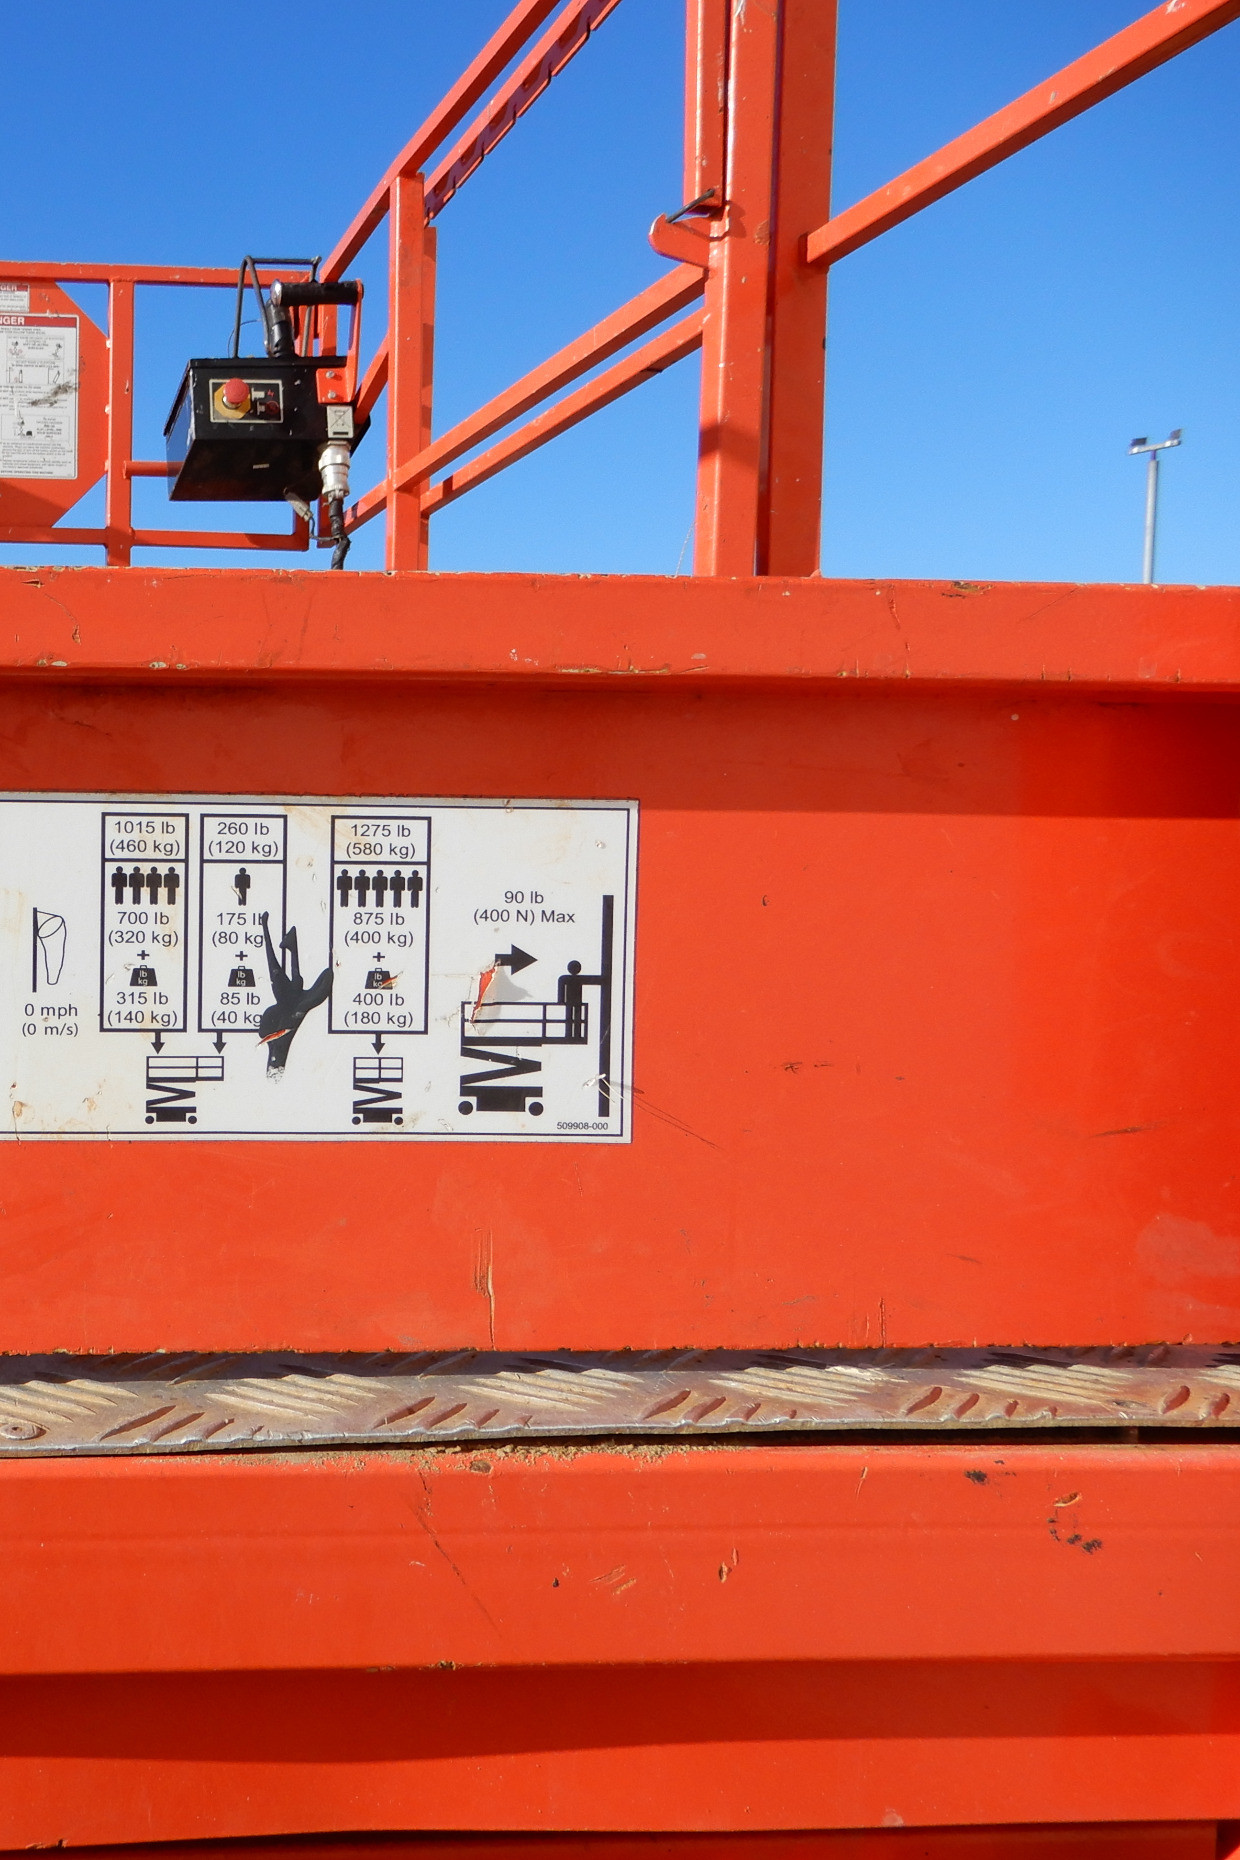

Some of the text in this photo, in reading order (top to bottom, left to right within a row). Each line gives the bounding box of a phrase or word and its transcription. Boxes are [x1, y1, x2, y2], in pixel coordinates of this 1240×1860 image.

[114, 820, 176, 834] 1015 lb
[216, 822, 270, 836] 260 lb
[350, 824, 412, 838] 1275 lb
[109, 839, 180, 856] (460 kg)
[208, 840, 279, 858] (120 kg)
[346, 842, 416, 860] (580 kg)
[504, 890, 545, 904] 90 lb
[117, 911, 170, 925] 700 lb
[216, 912, 247, 926] 175
[353, 911, 405, 926] 875 lb
[473, 908, 575, 926] (400 N) Max
[108, 930, 179, 947] (320 kg)
[211, 931, 264, 948] (80 kg
[344, 930, 414, 948] (400 kg)
[139, 970, 148, 978] lb
[138, 978, 148, 986] kg
[116, 991, 169, 1005] 315 lb
[220, 991, 261, 1005] 85 lb
[353, 992, 405, 1006] 400 lb
[24, 1003, 78, 1020] 0 mph
[107, 1010, 178, 1027] (140 kg)
[211, 1010, 263, 1027] (40 kg
[344, 1011, 414, 1028] (180 kg)
[21, 1022, 79, 1038] (0 m/s)
[556, 1121, 609, 1131] 509908-000
